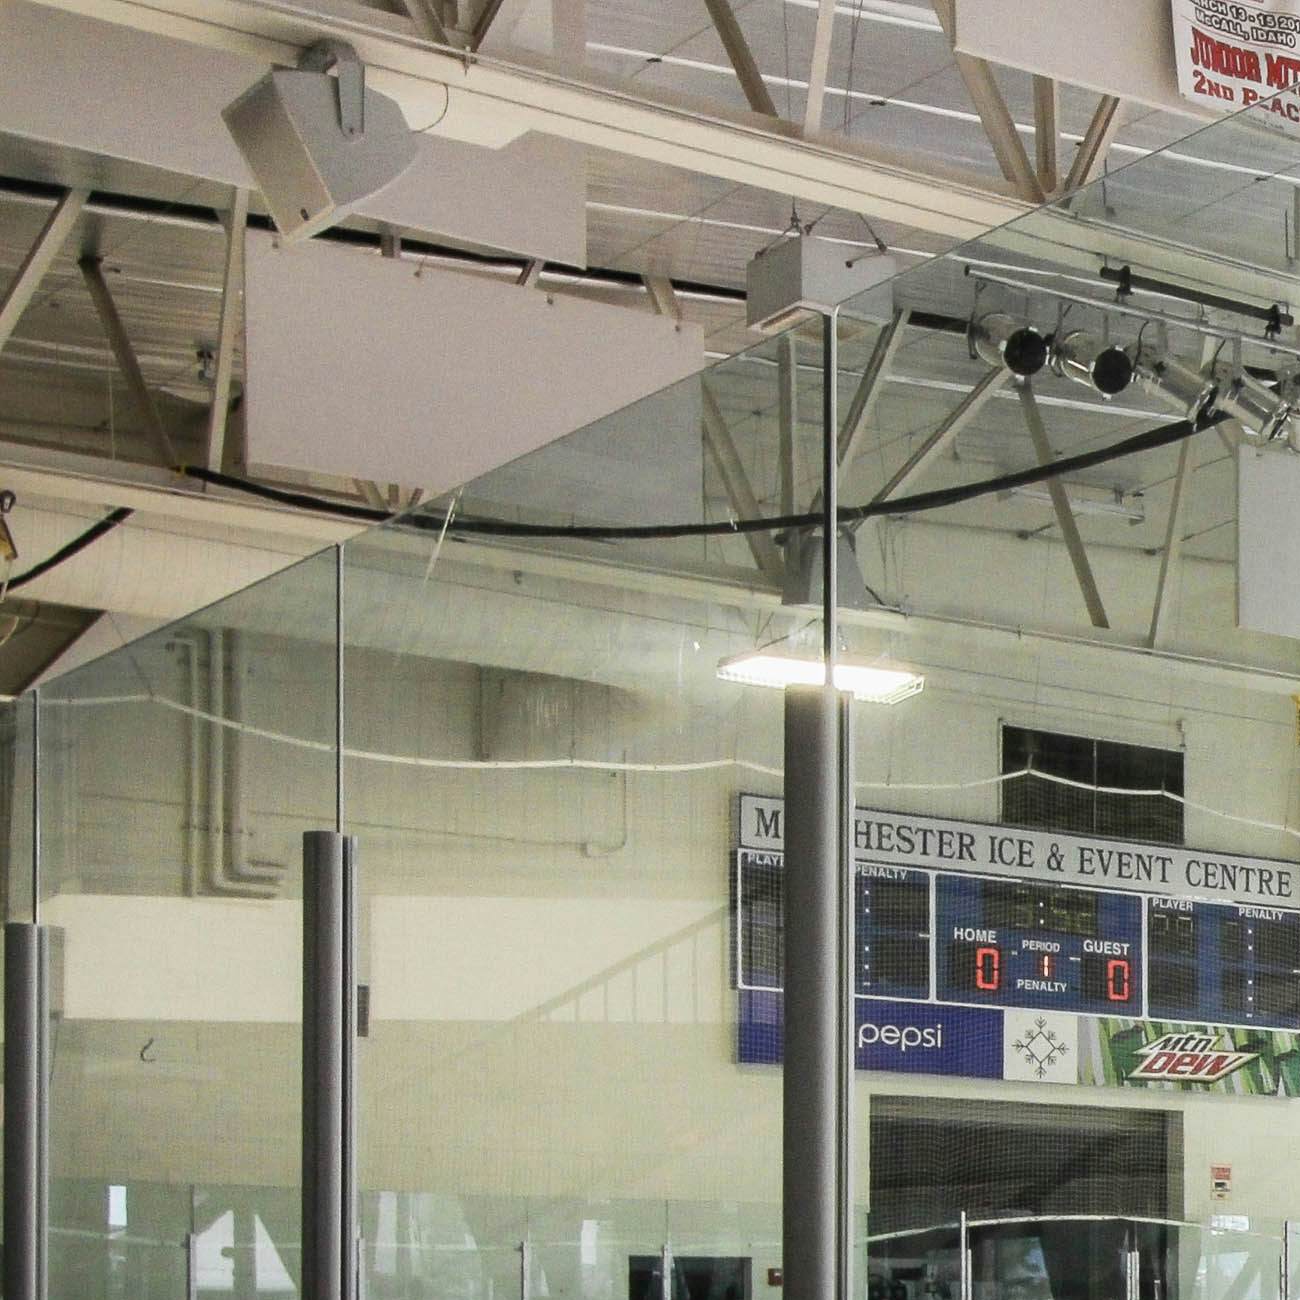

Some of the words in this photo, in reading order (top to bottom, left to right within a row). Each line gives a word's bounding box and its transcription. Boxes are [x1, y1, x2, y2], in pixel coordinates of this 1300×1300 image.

[1230, 6, 1247, 22] 13
[1257, 13, 1276, 28] 15
[1251, 27, 1296, 48] IDAHO
[1190, 26, 1262, 84] JUNIOR
[1193, 70, 1234, 102] 2ND
[754, 806, 977, 864] MHESTER
[989, 835, 1035, 869] ICE
[1047, 844, 1065, 872] &
[1078, 854, 1173, 885] EVENT
[1185, 860, 1293, 898] CENTRE
[1152, 898, 1194, 912] PLAYER
[1238, 907, 1284, 921] PENALTY
[953, 927, 998, 944] HOME
[1022, 939, 1060, 953] PERIOD
[1083, 939, 1131, 956] GUEST
[976, 947, 1000, 990] 0
[1043, 955, 1050, 977] 1
[1016, 978, 1068, 993] PENALTY
[1107, 959, 1130, 1000] 0
[857, 1022, 943, 1052] pepsi
